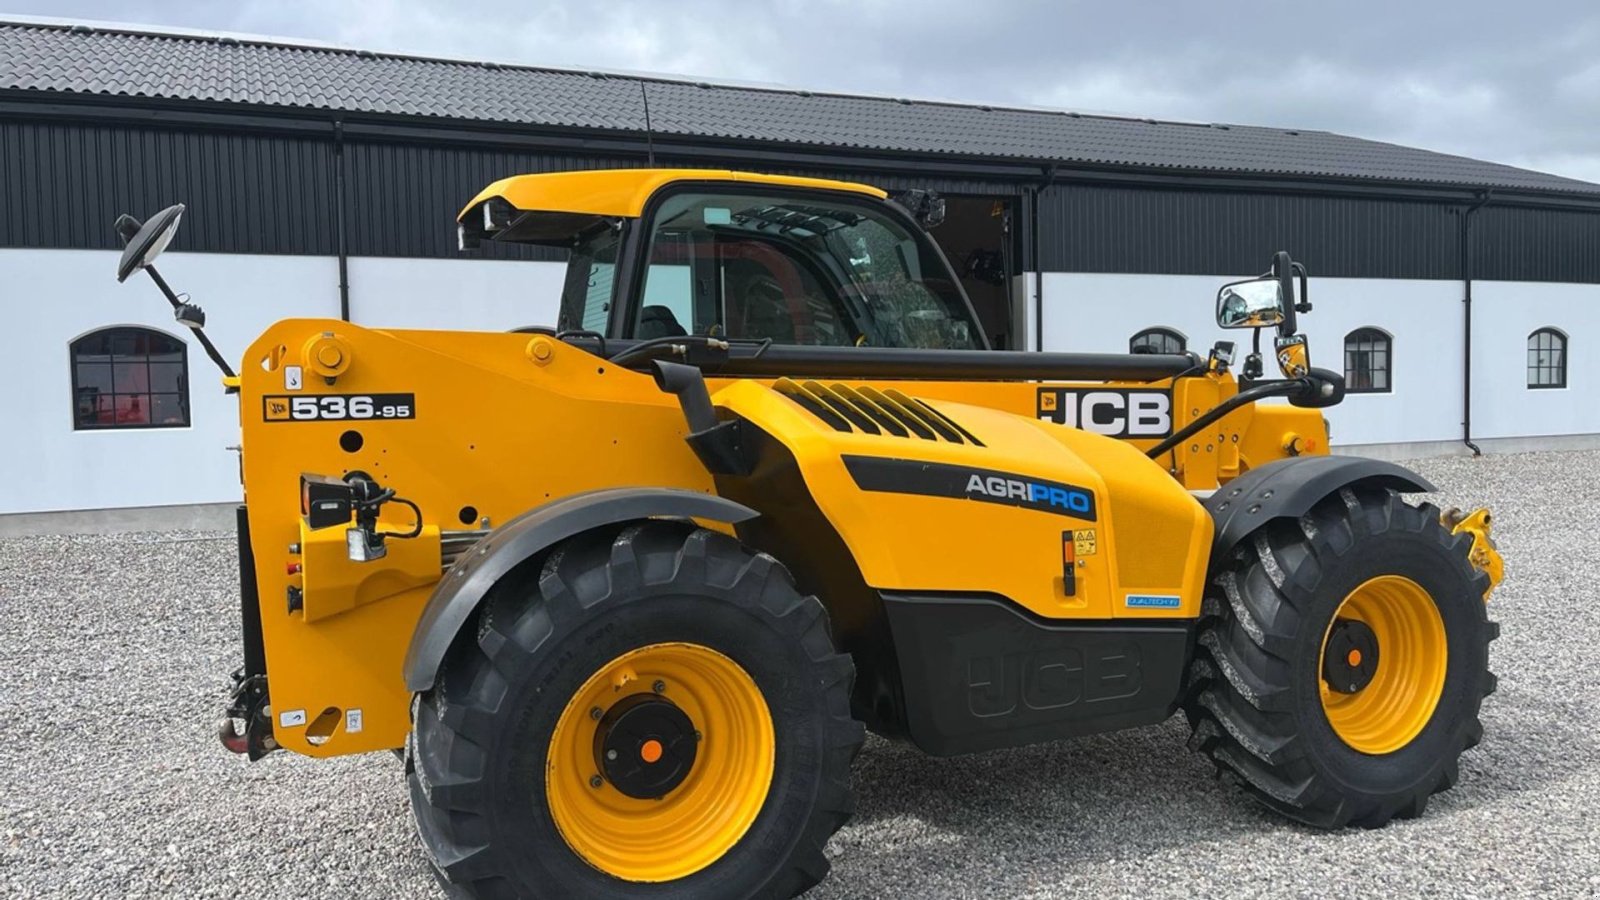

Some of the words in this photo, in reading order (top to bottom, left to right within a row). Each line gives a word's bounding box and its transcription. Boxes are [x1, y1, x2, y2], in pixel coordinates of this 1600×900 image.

[291, 396, 410, 420] 536-95
[1041, 391, 1171, 436] JCB
[965, 474, 1089, 513] AGRIPRO
[968, 641, 1145, 718] JCB
